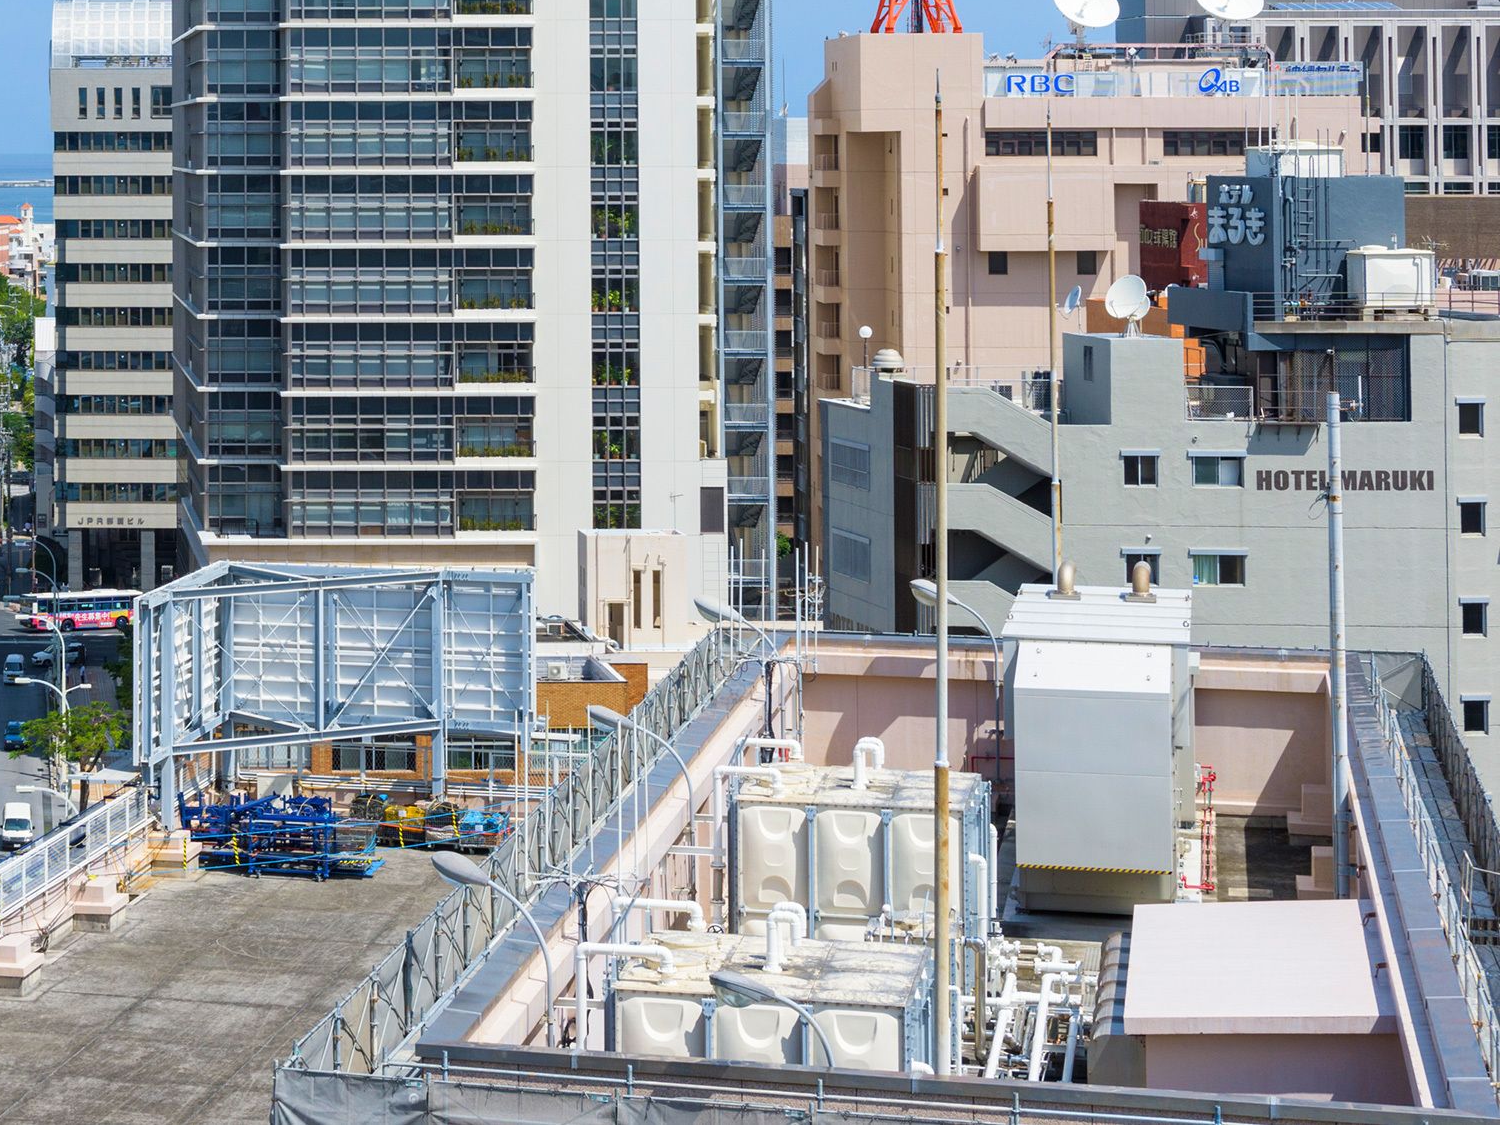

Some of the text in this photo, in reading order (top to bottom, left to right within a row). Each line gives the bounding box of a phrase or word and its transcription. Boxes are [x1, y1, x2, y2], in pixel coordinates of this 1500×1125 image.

[1006, 74, 1075, 94] RBC
[1218, 184, 1254, 205] ホテル
[1207, 206, 1266, 247] まるき
[1256, 470, 1435, 491] HOTEL MARUKI
